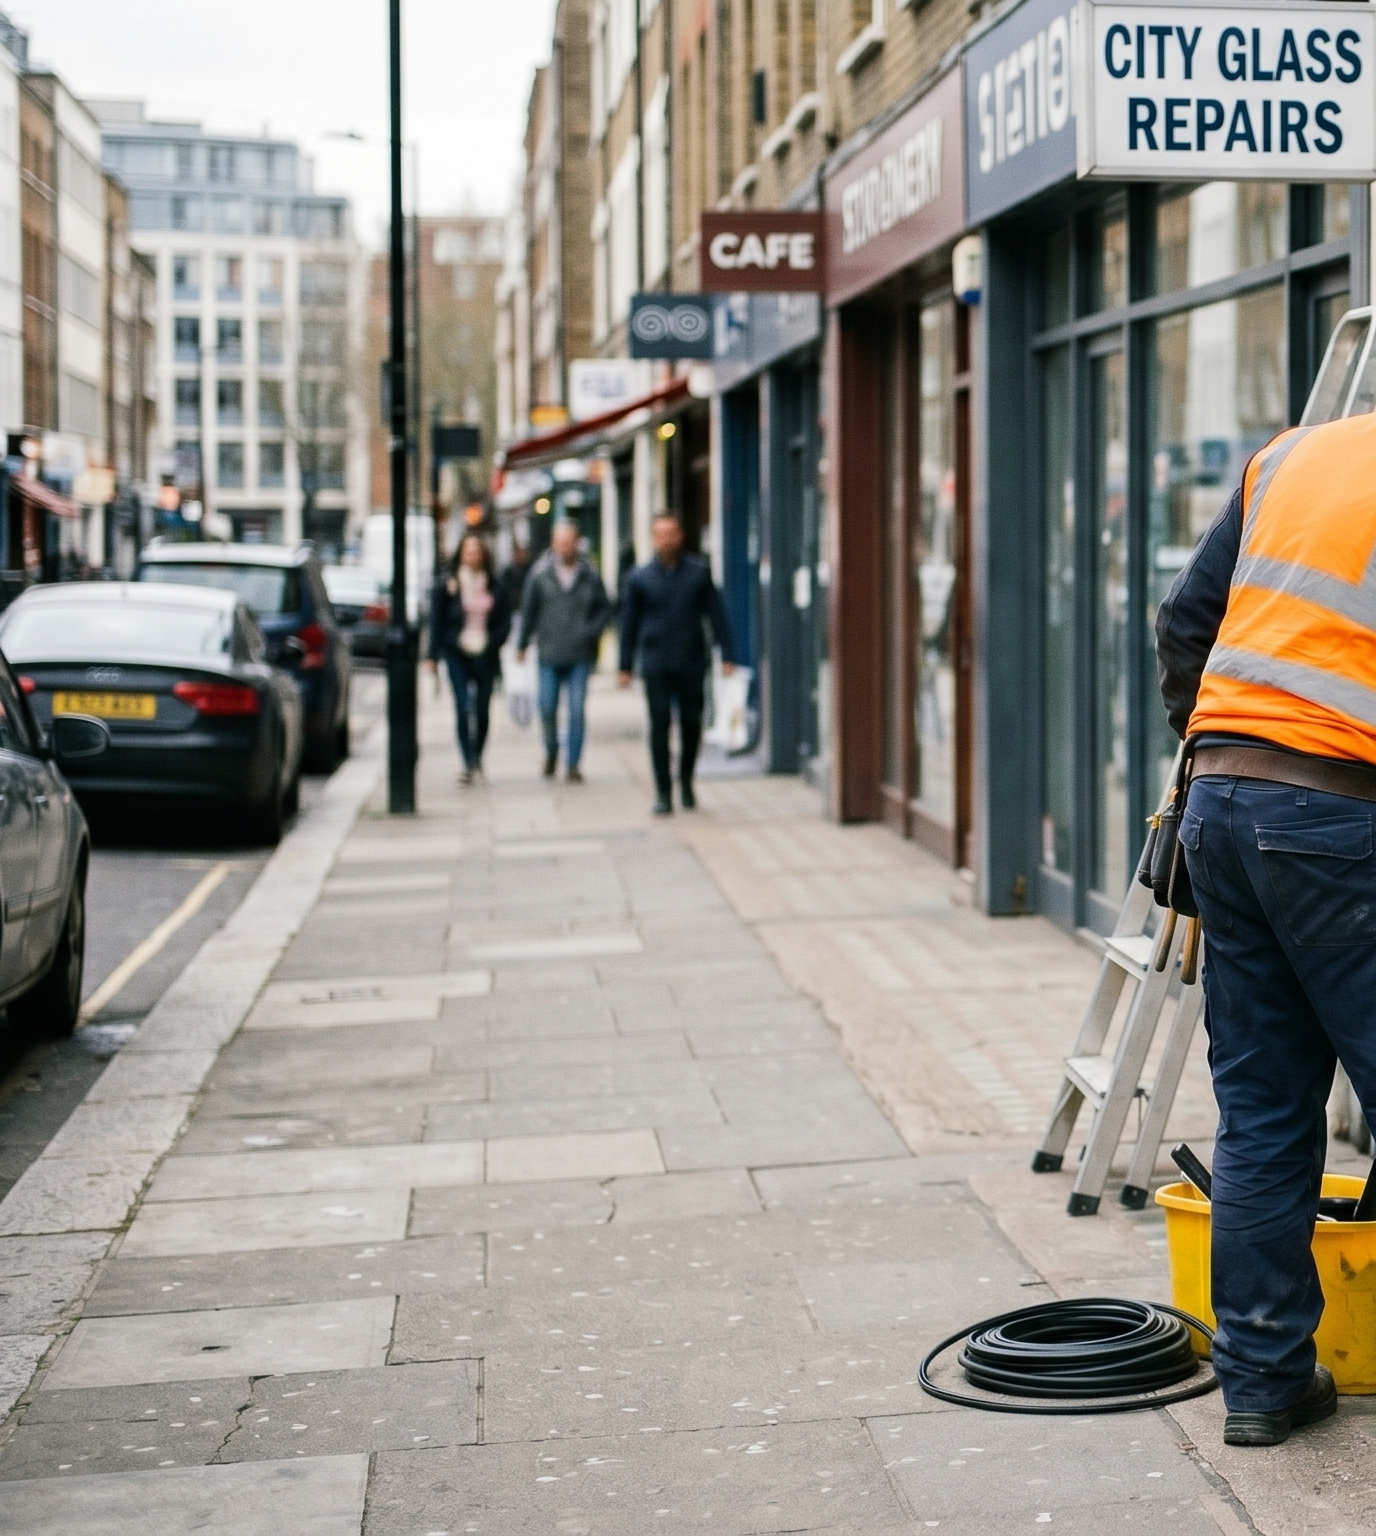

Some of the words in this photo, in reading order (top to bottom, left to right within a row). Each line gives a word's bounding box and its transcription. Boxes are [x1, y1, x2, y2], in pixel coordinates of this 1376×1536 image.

[1104, 23, 1203, 80] CITY
[1217, 26, 1362, 84] GLASS
[1127, 97, 1343, 154] REPAIRS
[708, 231, 816, 270] CAFE
